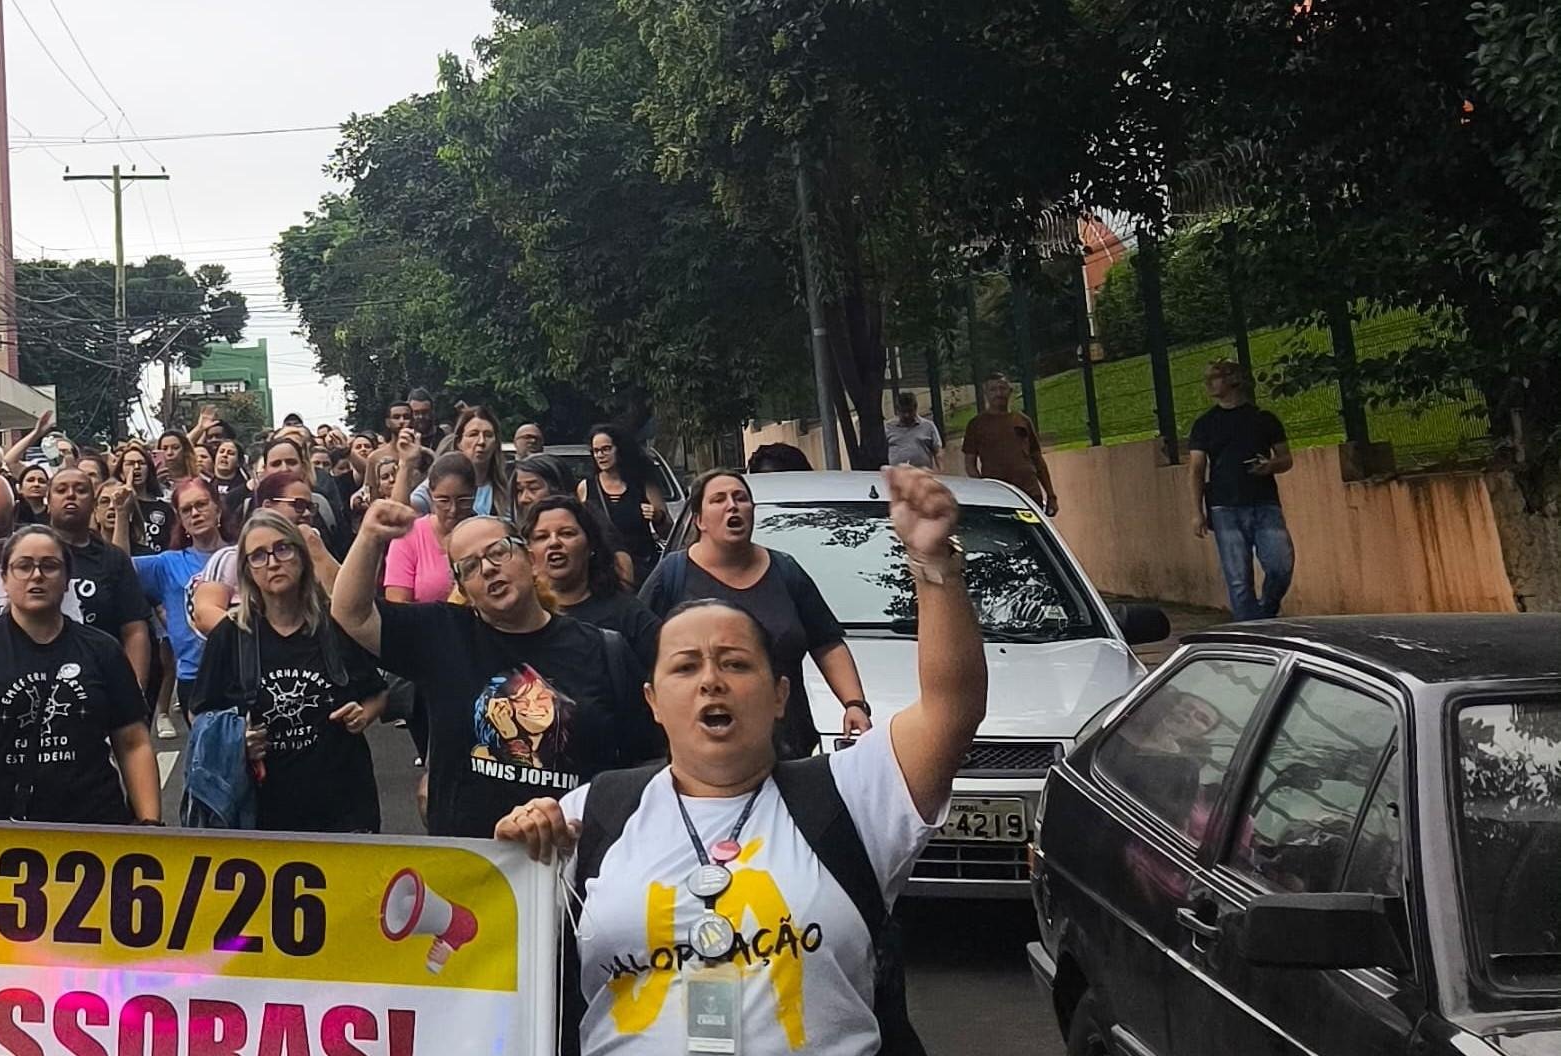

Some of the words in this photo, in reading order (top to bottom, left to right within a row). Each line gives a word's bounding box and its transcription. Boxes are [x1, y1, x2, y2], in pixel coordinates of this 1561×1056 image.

[1, 678, 26, 705] EMEF
[26, 672, 47, 683] ERN
[40, 736, 68, 748] ISTO
[5, 754, 26, 764] EST
[519, 767, 579, 790] JOPLIN
[599, 913, 823, 980] VALORAÇÃO
